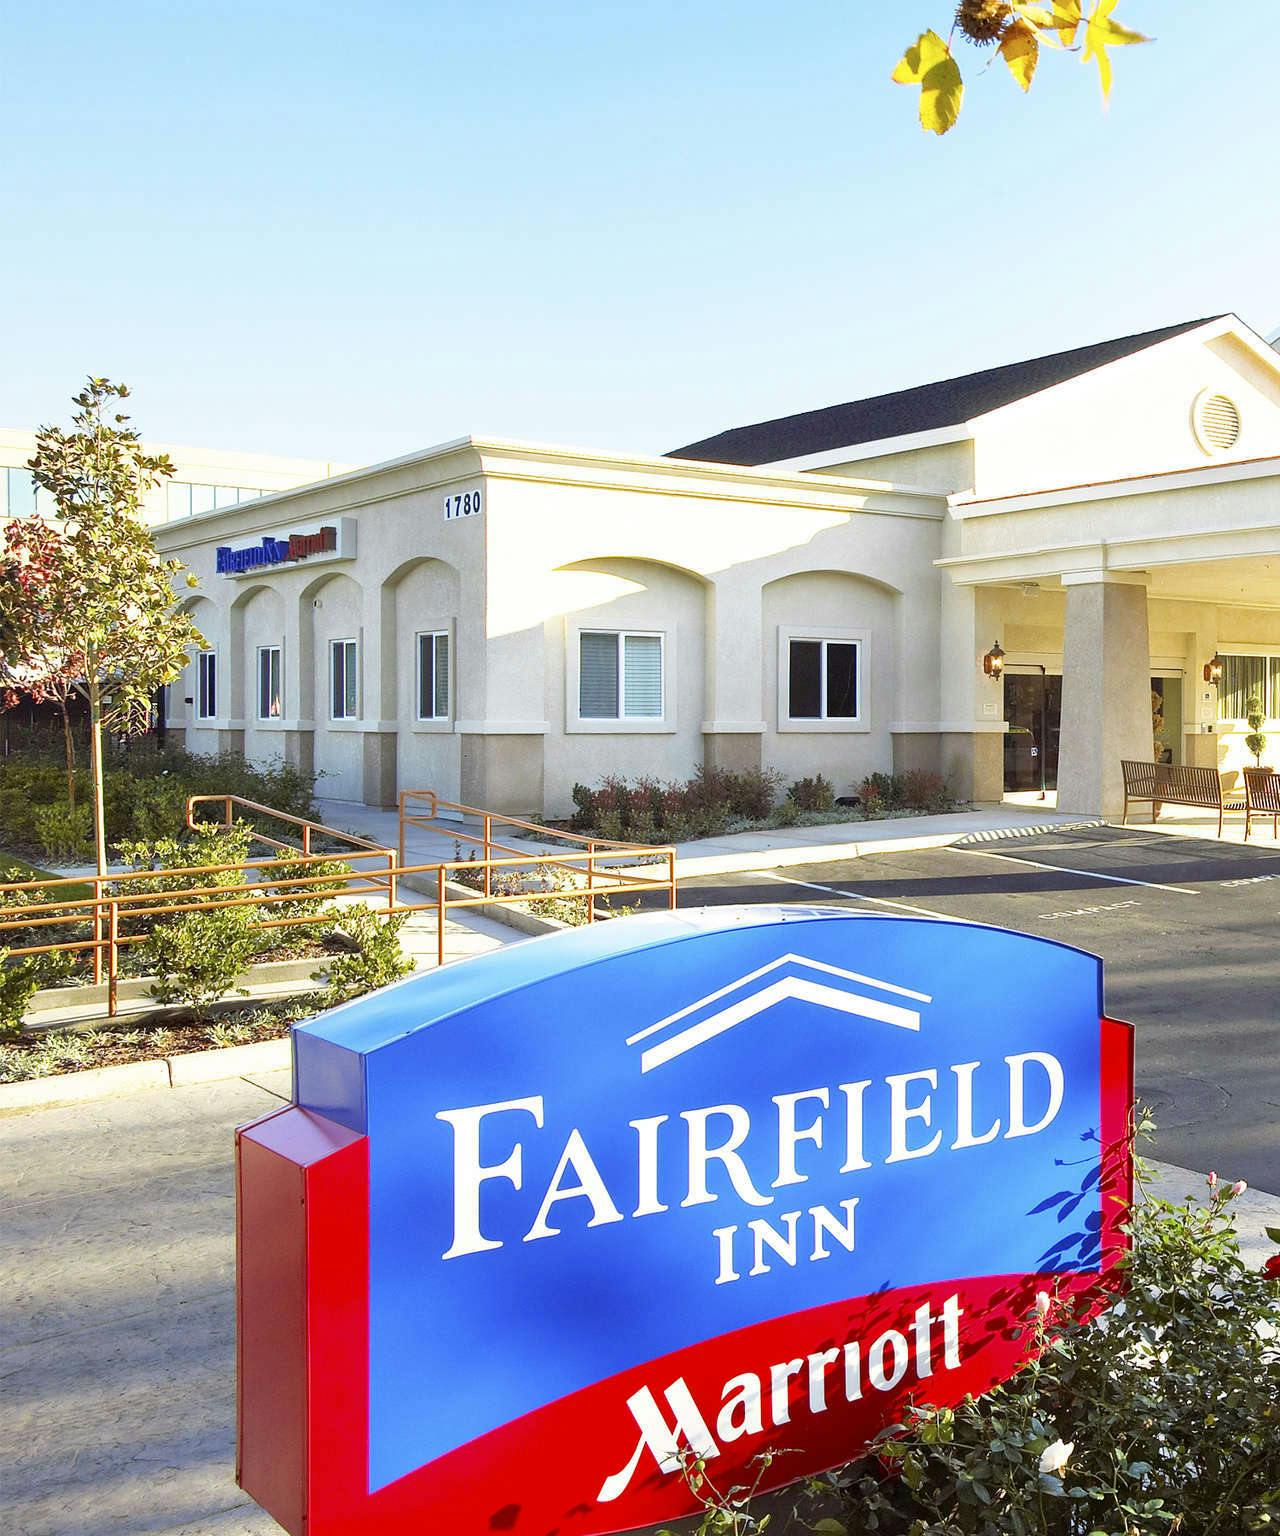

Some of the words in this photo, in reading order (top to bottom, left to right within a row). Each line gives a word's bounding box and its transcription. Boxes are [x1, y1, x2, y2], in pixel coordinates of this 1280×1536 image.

[445, 491, 481, 518] 1780
[1038, 900, 1142, 920] COMPACT
[434, 1051, 1066, 1261] FAIRFIELD
[712, 1197, 860, 1285] INN
[596, 1293, 964, 1503] Marriott
